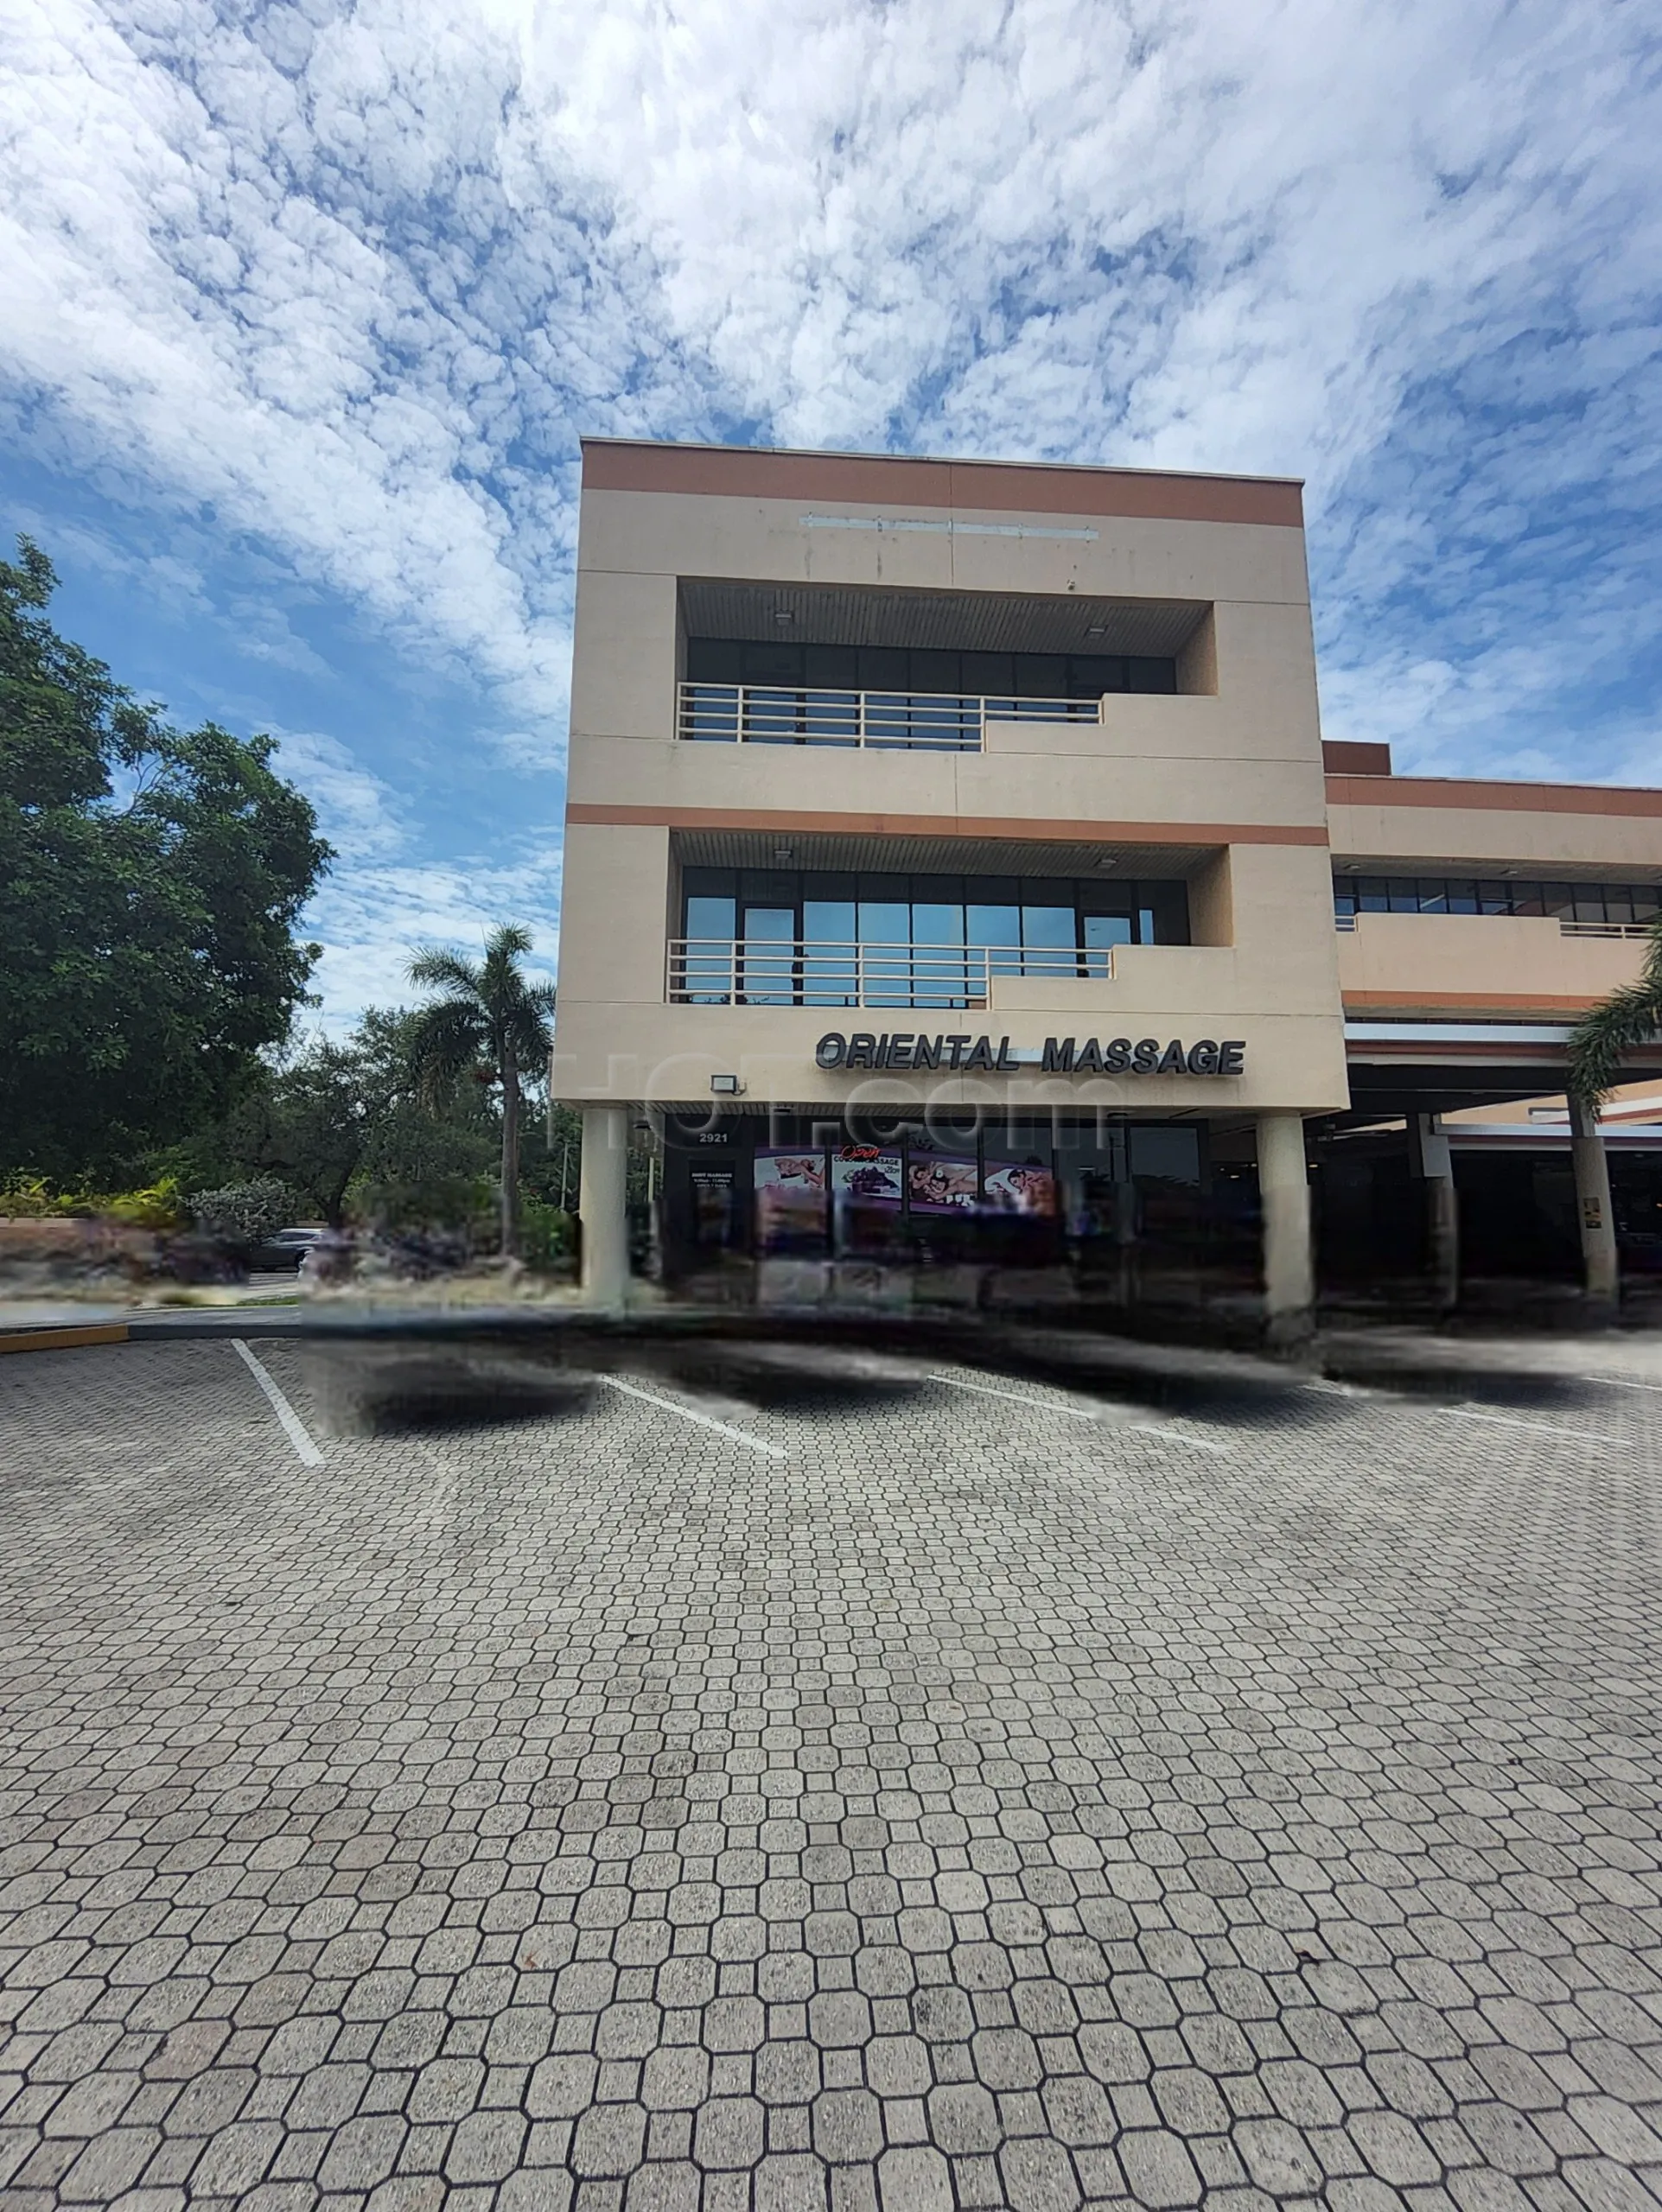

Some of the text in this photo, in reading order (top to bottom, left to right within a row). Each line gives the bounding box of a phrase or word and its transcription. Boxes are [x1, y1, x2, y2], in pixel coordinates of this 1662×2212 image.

[815, 1033, 1246, 1076] ORIENTAL MASSAGE
[699, 1133, 728, 1143] 2921
